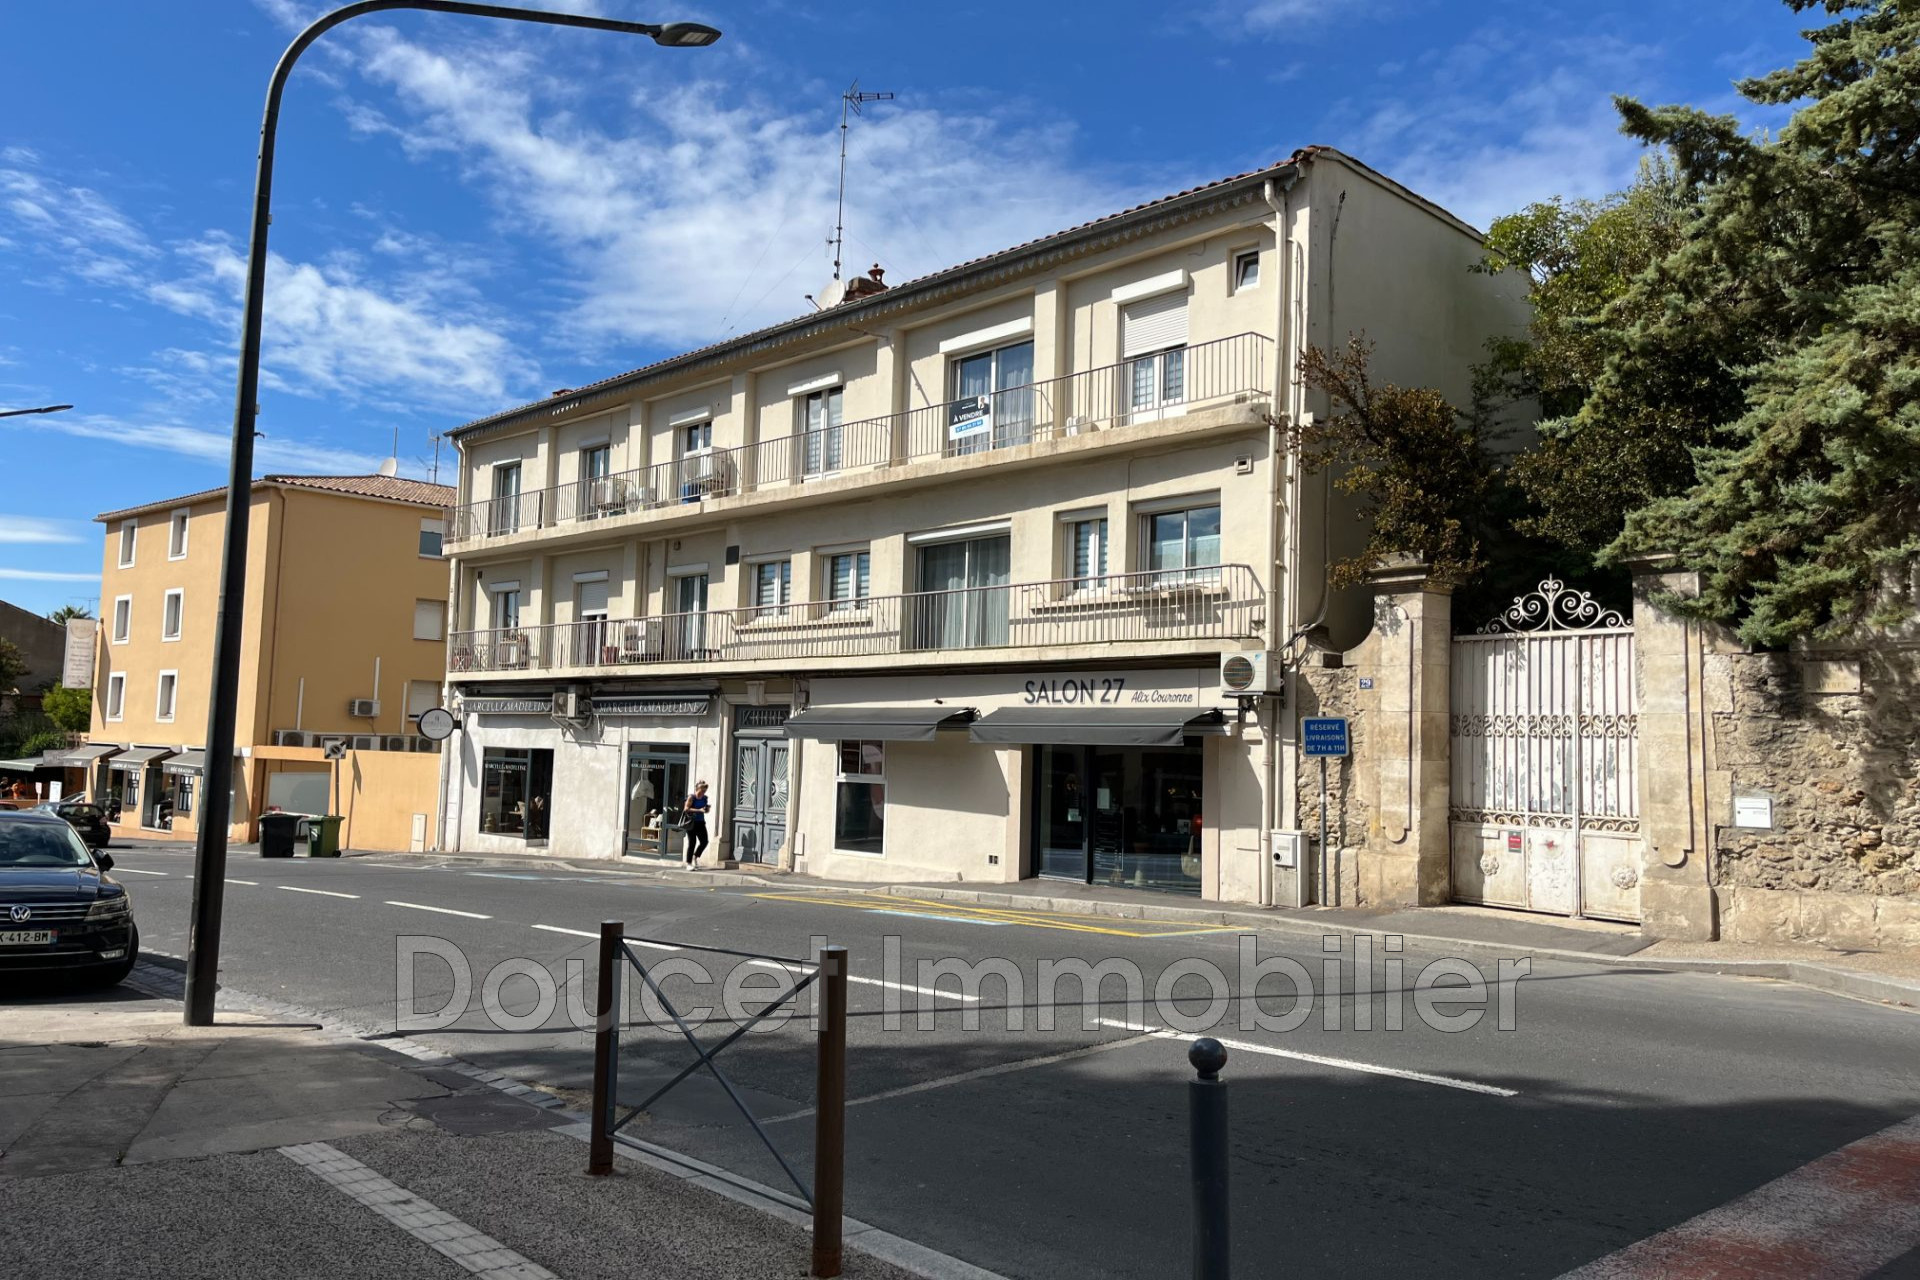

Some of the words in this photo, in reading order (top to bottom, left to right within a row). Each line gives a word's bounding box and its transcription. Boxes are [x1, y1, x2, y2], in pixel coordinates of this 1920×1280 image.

[959, 410, 984, 421] VENDRE
[1024, 678, 1094, 704] SALON
[1100, 678, 1125, 704] 27
[1131, 690, 1150, 703] Alix
[1151, 690, 1193, 703] Couronne
